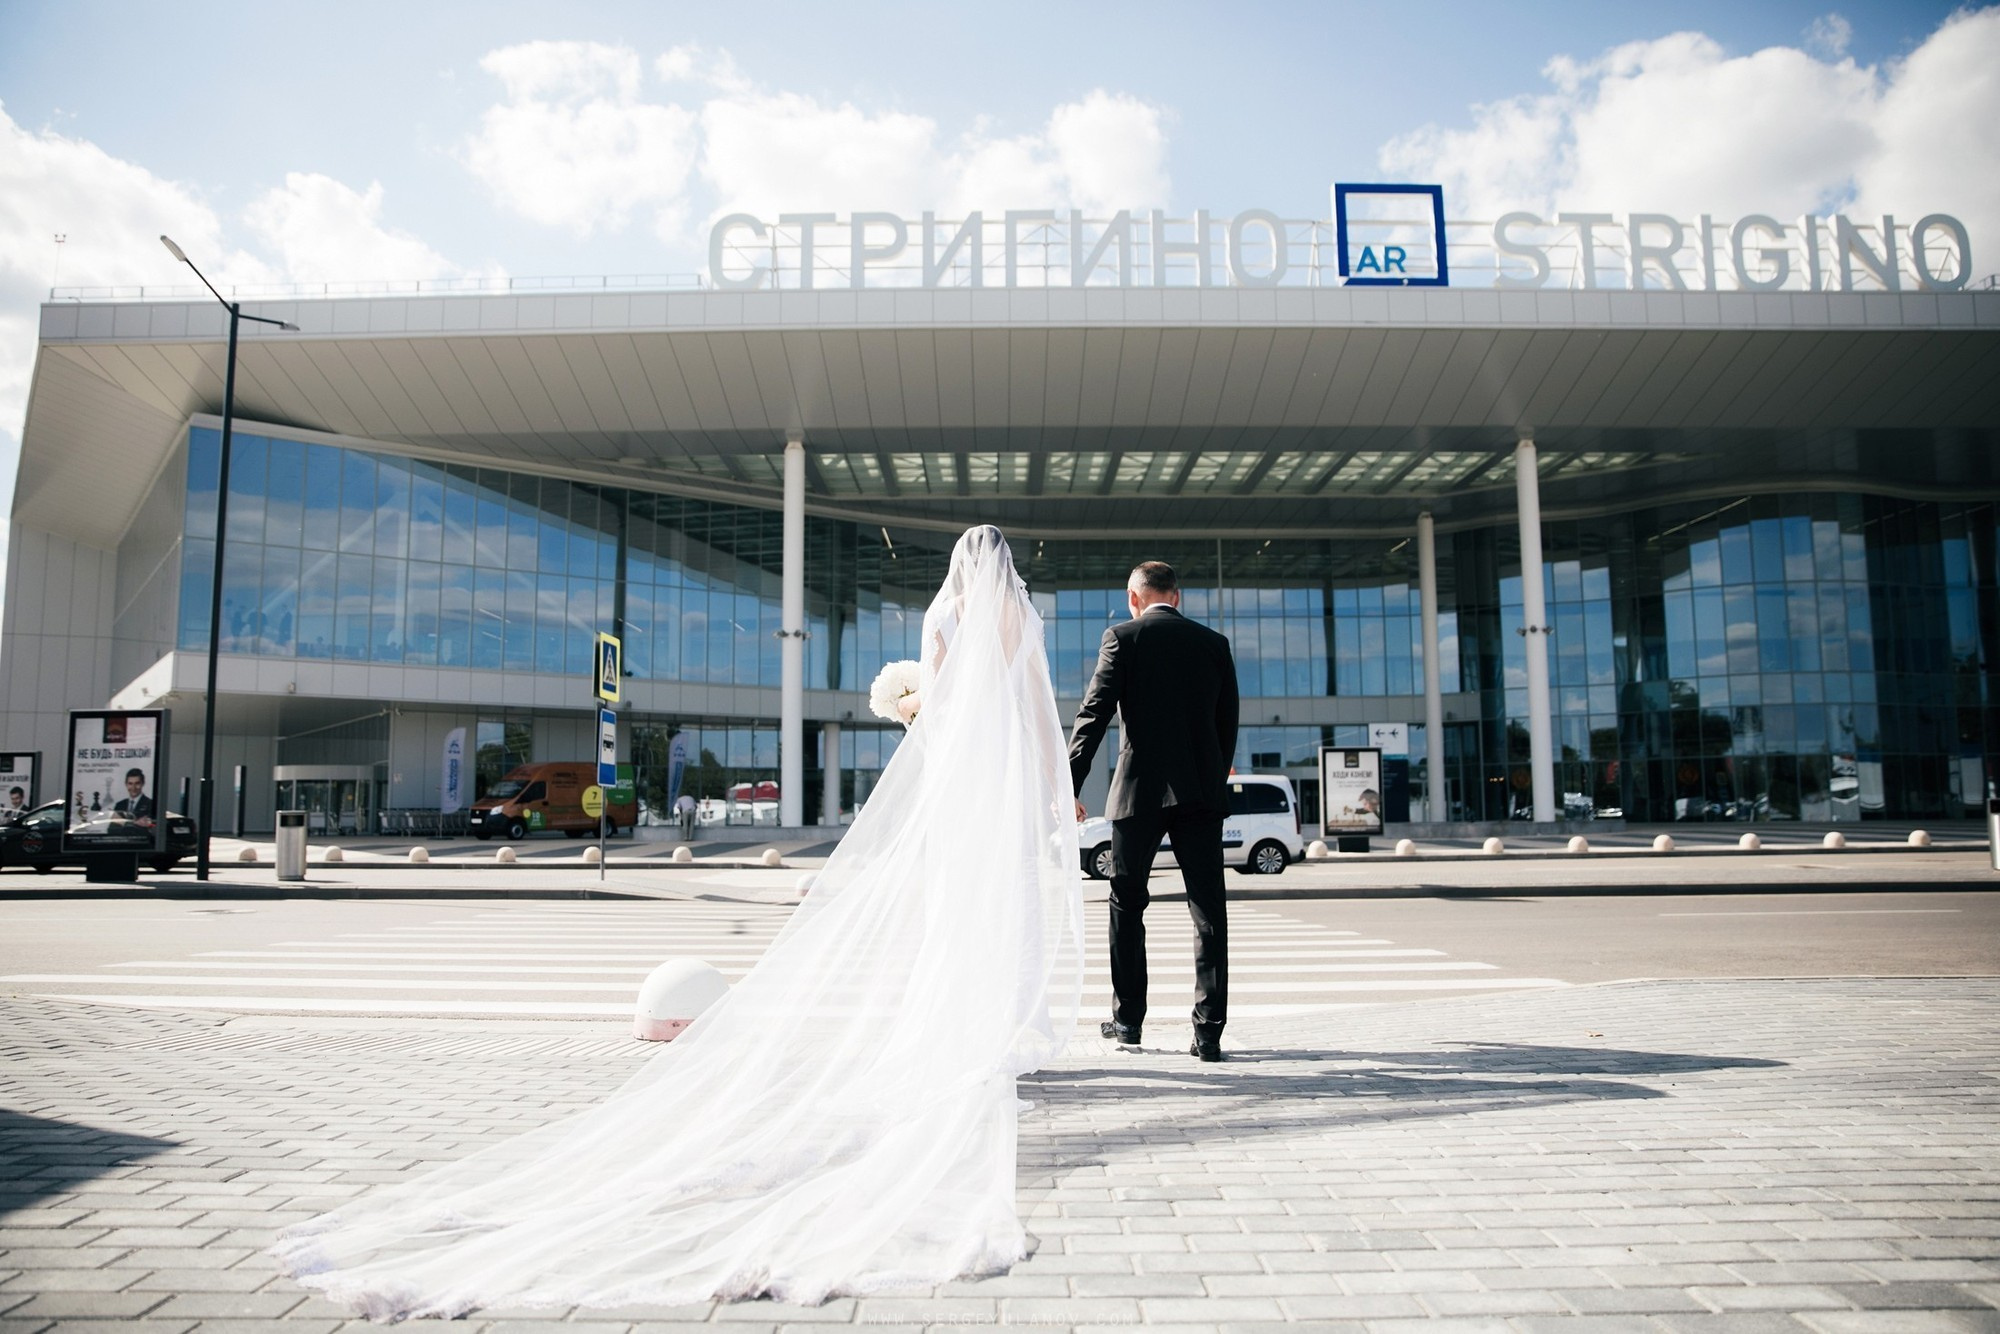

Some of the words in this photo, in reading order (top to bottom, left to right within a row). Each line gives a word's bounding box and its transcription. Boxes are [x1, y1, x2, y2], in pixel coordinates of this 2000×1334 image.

[708, 209, 1288, 290] СТРИГИНО
[1356, 246, 1406, 272] AR
[1494, 211, 1972, 291] STRIGINO
[77, 749, 90, 759] НЕ
[91, 748, 113, 759] БУДЬ
[592, 791, 598, 800] 7
